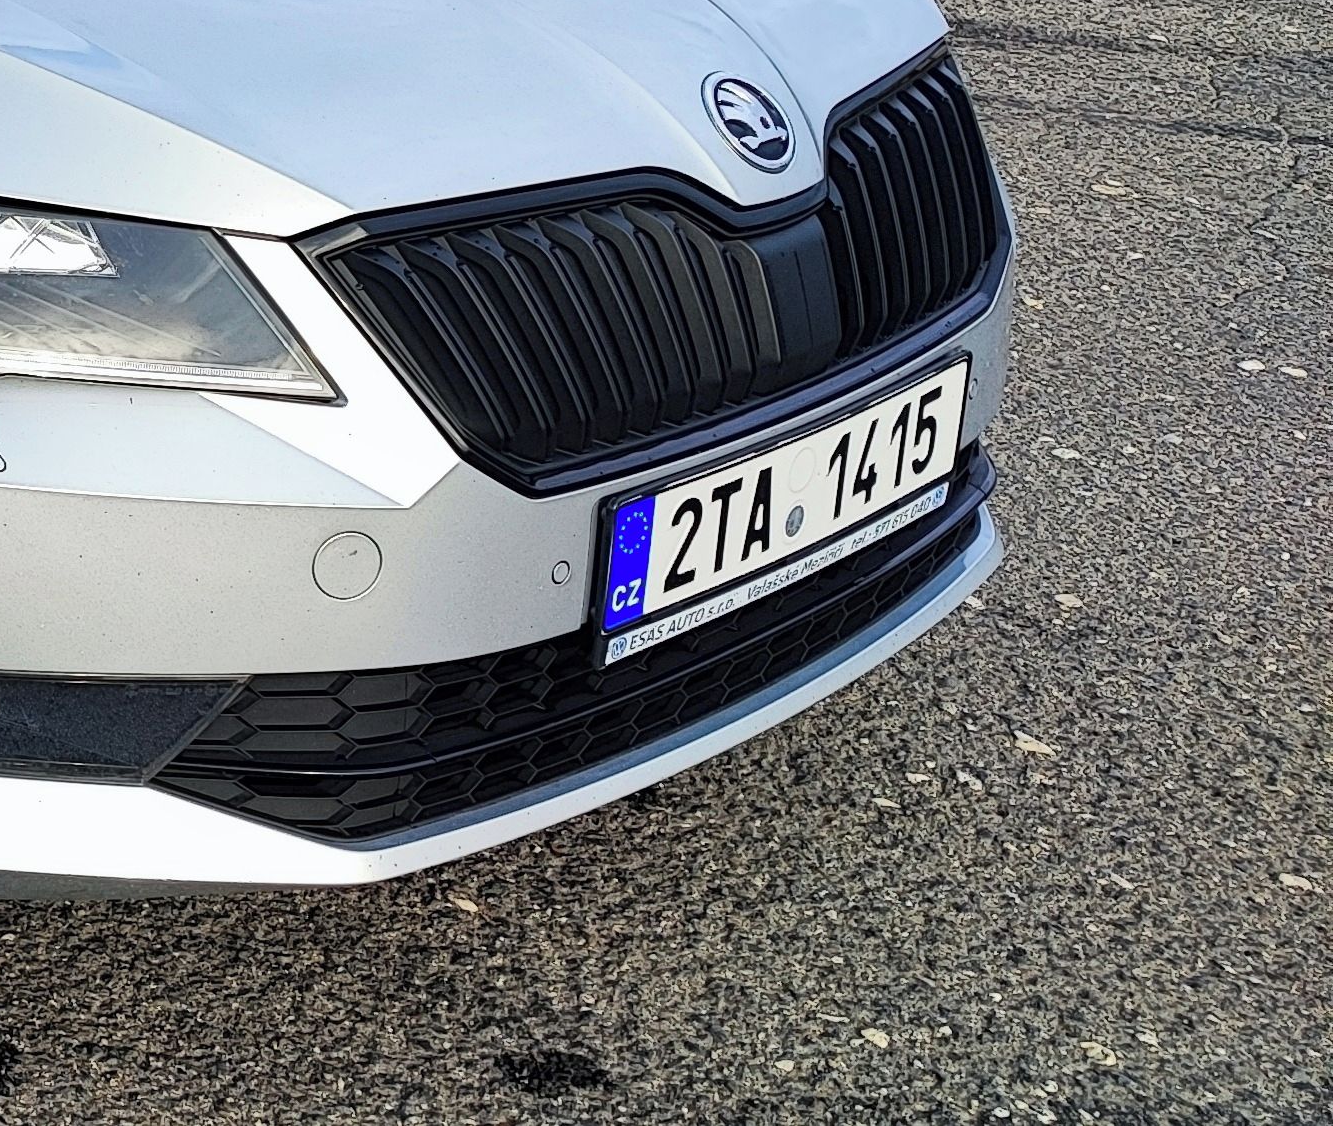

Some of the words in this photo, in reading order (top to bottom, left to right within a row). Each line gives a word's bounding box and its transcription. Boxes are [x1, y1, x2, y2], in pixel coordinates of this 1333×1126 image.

[663, 466, 773, 594] 2TA
[828, 385, 943, 520] 1415
[612, 578, 643, 613] CZ
[629, 623, 665, 650] ESAS
[666, 607, 705, 635] AUTO
[747, 565, 799, 600] Valašské
